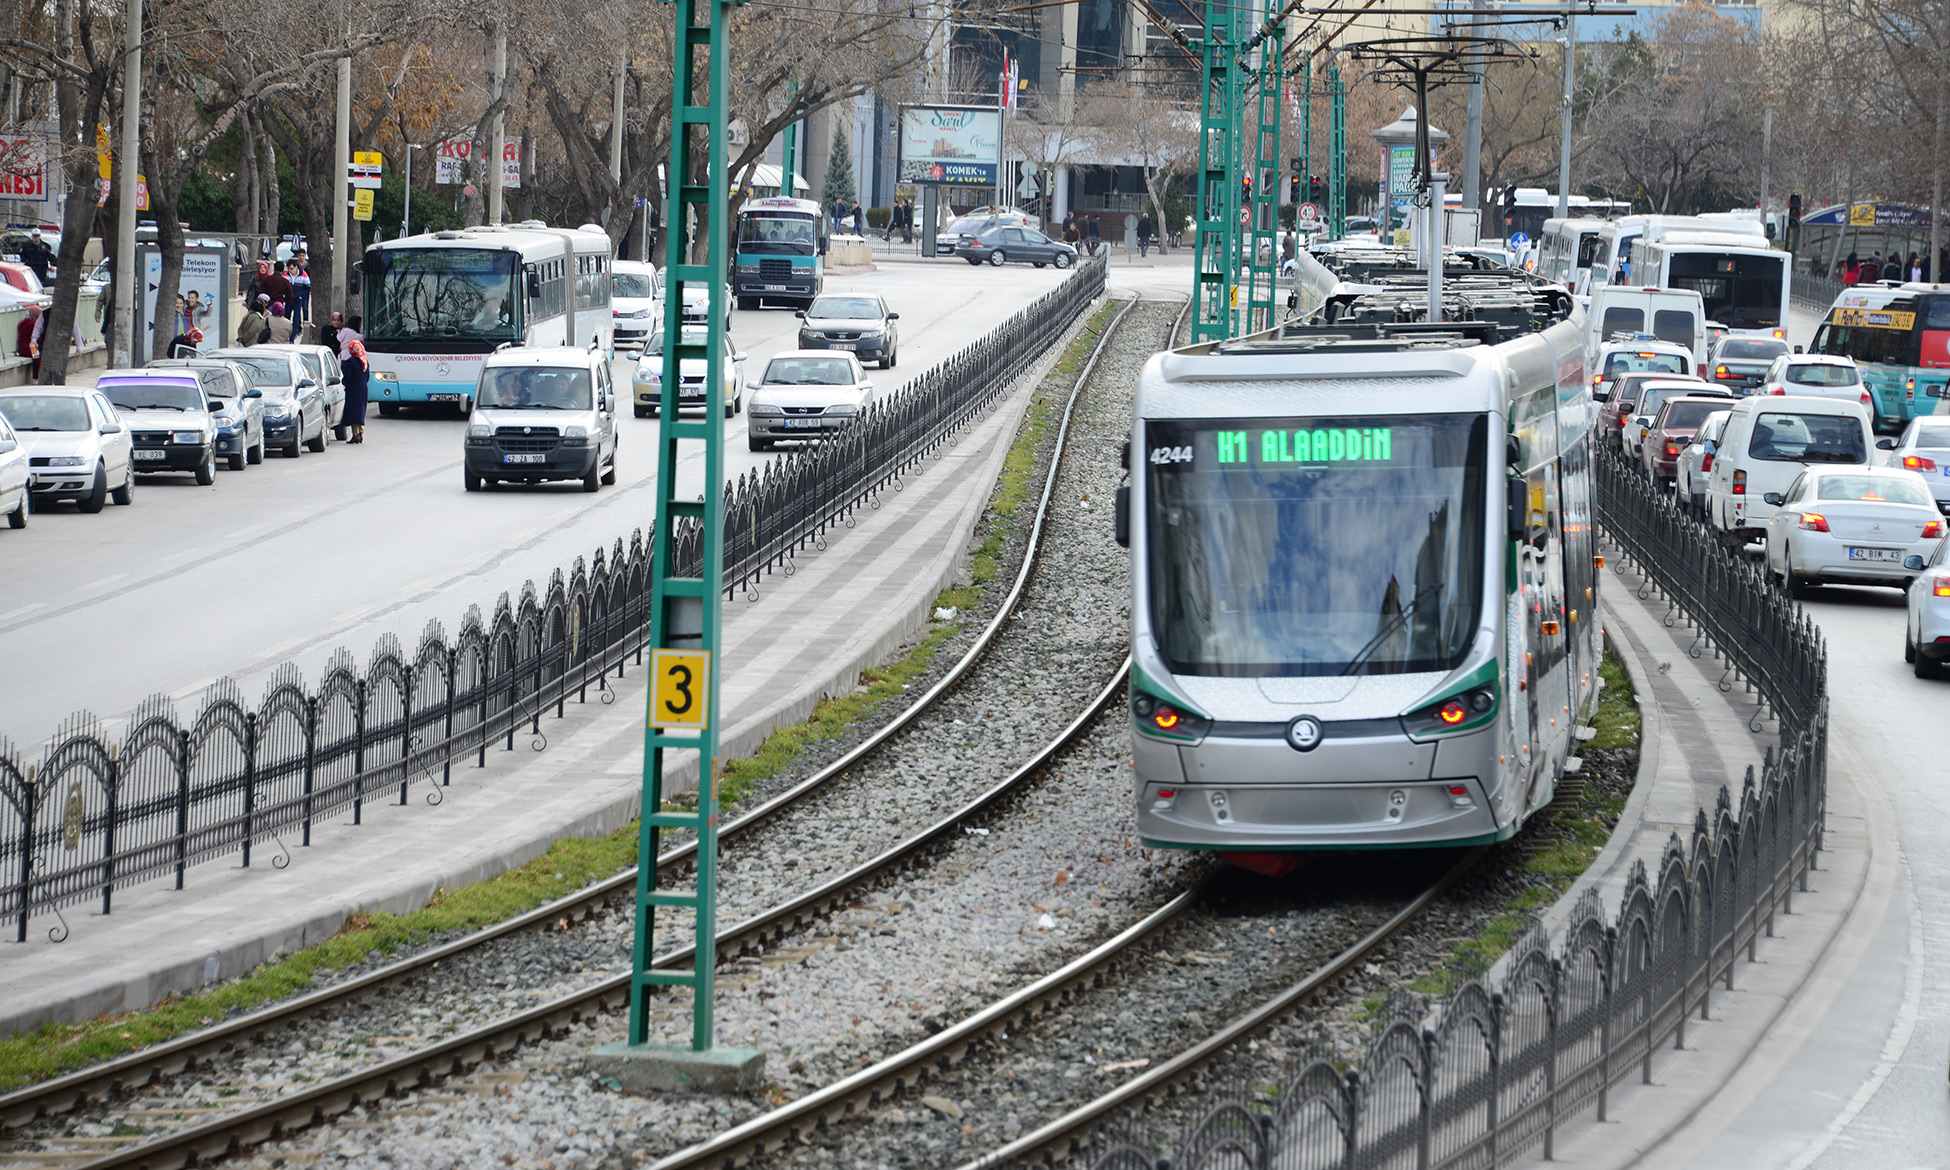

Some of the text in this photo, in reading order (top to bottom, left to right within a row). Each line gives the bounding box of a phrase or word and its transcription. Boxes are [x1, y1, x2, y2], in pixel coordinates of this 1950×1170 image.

[946, 165, 987, 176] KOMEK'te
[1150, 446, 1193, 465] 4244
[1218, 431, 1247, 463] H1
[1855, 549, 1864, 558] 42
[666, 664, 693, 714] 3
